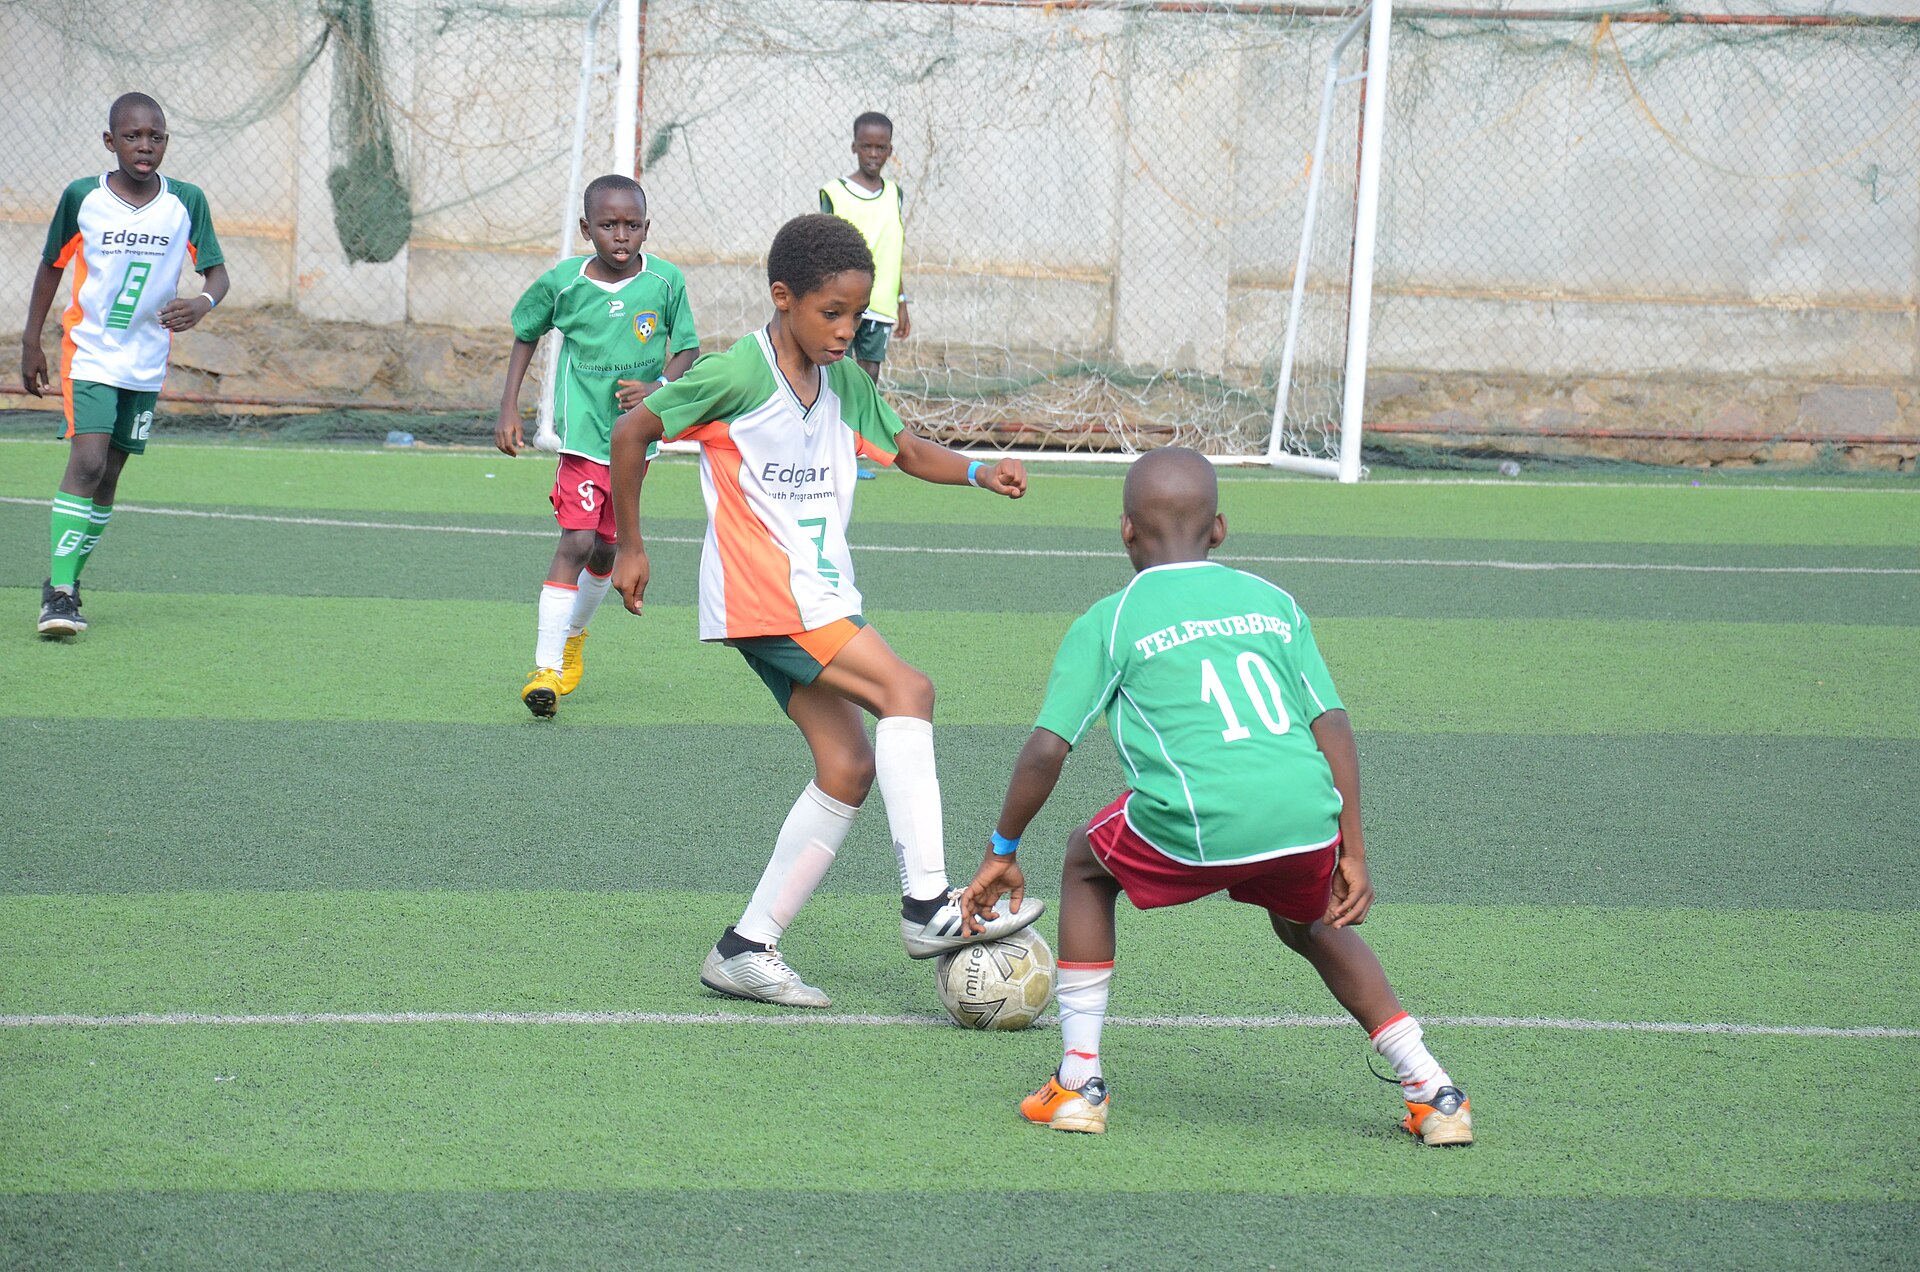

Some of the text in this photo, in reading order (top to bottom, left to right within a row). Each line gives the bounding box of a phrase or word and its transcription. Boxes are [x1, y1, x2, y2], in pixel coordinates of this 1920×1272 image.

[101, 229, 170, 247] Edgars
[124, 249, 165, 257] Programme
[614, 364, 632, 372] Kids
[633, 357, 656, 369] League
[130, 410, 154, 440] 12
[762, 462, 834, 488] Edgar
[577, 479, 595, 512] 9
[768, 491, 787, 500] uth
[1134, 613, 1292, 660] TELETUBBIES
[1201, 651, 1291, 743] 10
[965, 948, 983, 997] mitre
